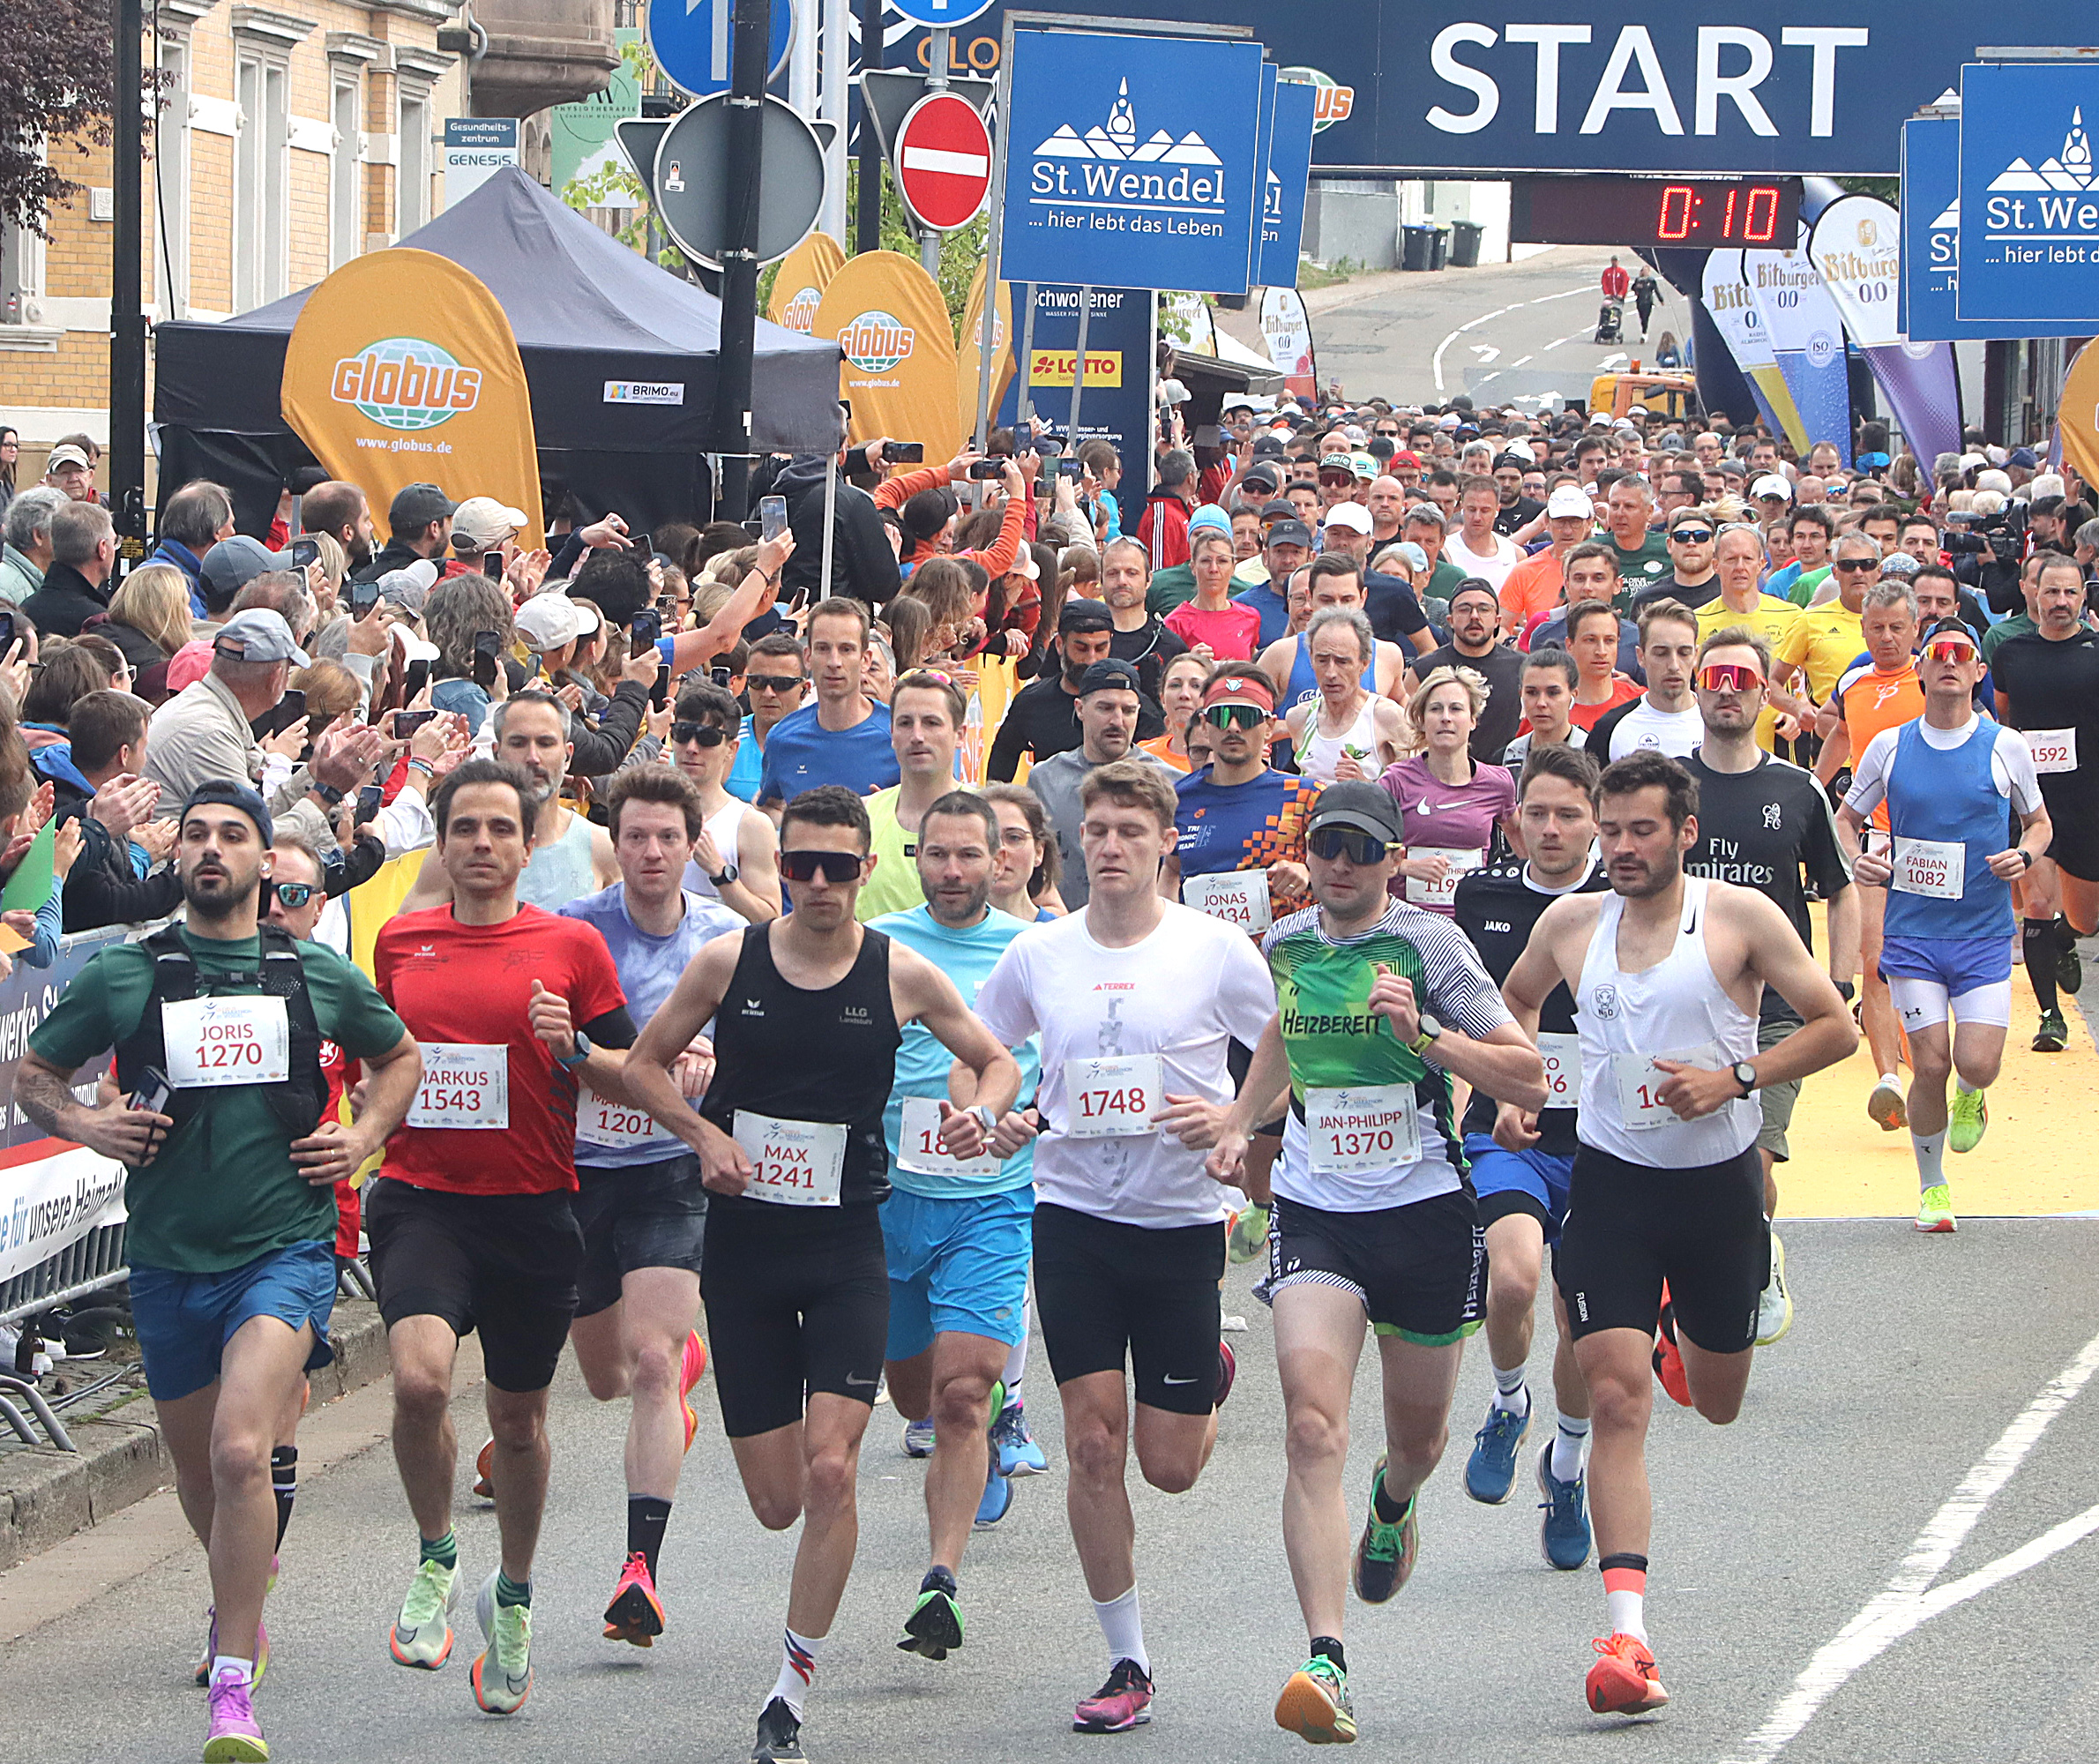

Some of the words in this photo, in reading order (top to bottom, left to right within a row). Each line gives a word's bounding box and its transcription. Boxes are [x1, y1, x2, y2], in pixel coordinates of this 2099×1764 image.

[1424, 22, 1869, 138] START
[450, 122, 511, 132] Gesundheits-
[461, 134, 499, 143] zentrum
[1048, 210, 1085, 229] hier
[1089, 213, 1125, 231] lebt
[1130, 215, 1162, 234] das
[1167, 217, 1222, 237] Leben
[2005, 245, 2043, 264] hier
[2048, 245, 2086, 264] lebt
[1812, 341, 1829, 352] ISO
[849, 378, 900, 389] www.globus.de
[355, 437, 452, 454] www.globus.de
[2030, 746, 2068, 763] 1592
[1709, 837, 1738, 859] Fly
[1686, 857, 1774, 885] mirates
[1906, 856, 1947, 871] FABIAN
[1907, 868, 1946, 886] 1082
[1204, 892, 1247, 907] JONAS
[1484, 920, 1511, 932] JAKO
[845, 1006, 868, 1017] LLG
[199, 1023, 253, 1042] JORIS
[196, 1043, 262, 1068] 1270
[421, 1088, 481, 1111] 1543
[1079, 1087, 1146, 1117] 1748
[597, 1110, 654, 1136] 1201
[1318, 1110, 1402, 1129] JAN-PHILIPP
[1331, 1130, 1393, 1155] 1370
[764, 1144, 809, 1163] MAX
[753, 1161, 815, 1189] 1241
[9, 1196, 28, 1250] für
[28, 1194, 71, 1243] unsere
[1576, 1291, 1589, 1323] FUSION
